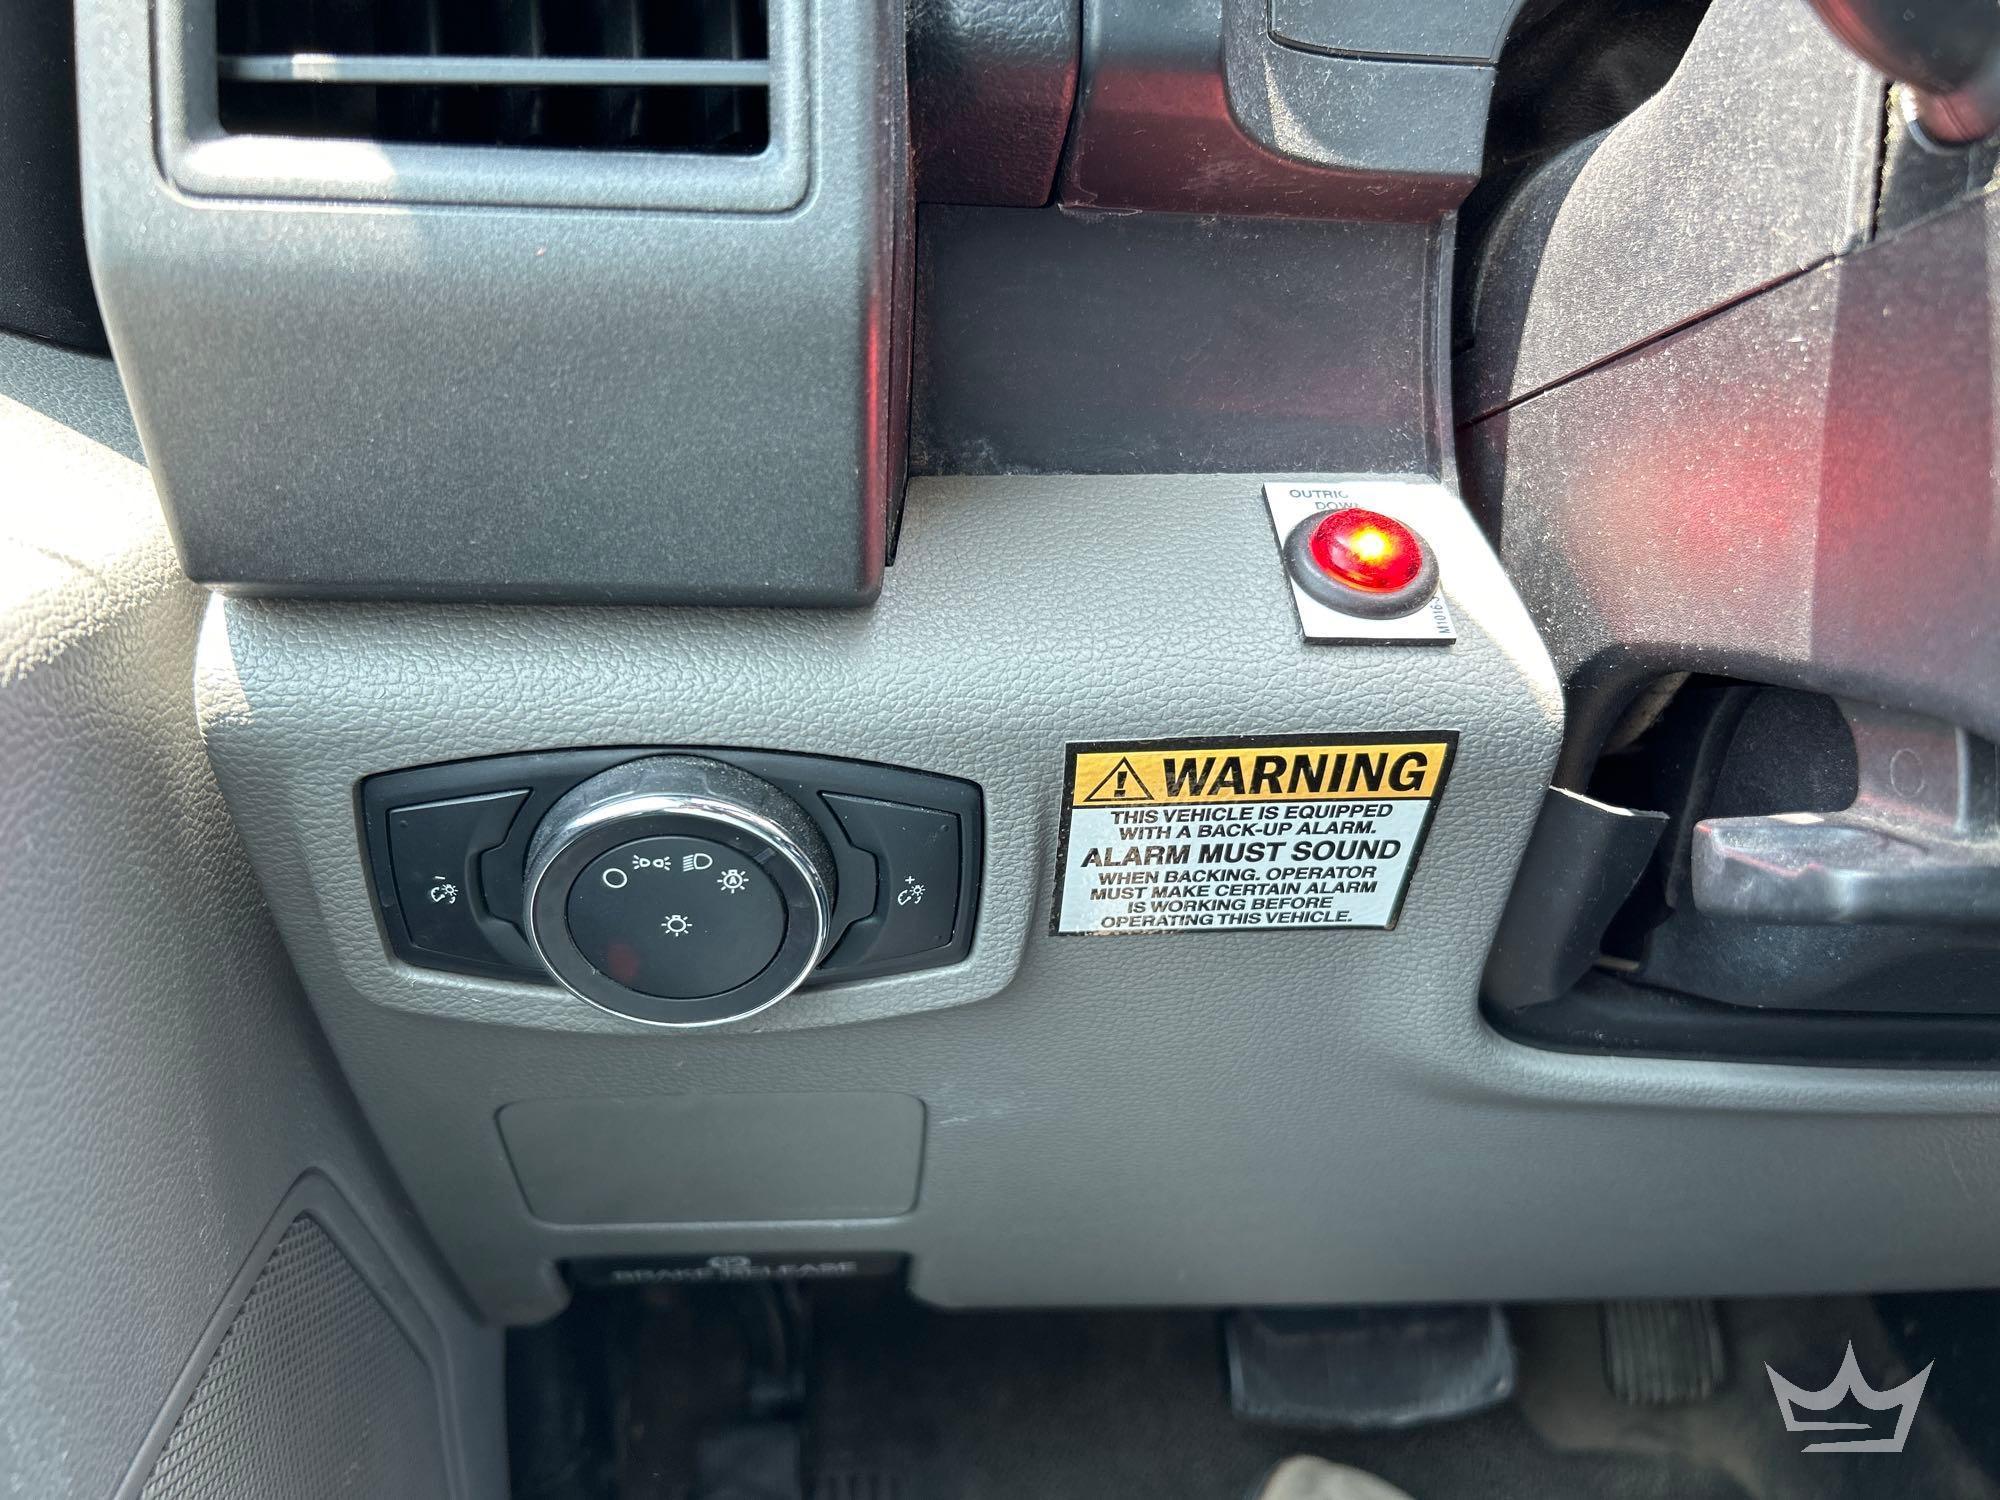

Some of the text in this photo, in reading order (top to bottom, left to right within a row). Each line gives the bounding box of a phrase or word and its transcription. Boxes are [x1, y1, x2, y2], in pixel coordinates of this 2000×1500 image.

[1162, 751, 1428, 797] WARNING
[1110, 803, 1393, 825] THIS VEHICLE IS EQUIPPED
[1119, 820, 1377, 840] WITH A BACK-UP ALARM.
[1080, 839, 1402, 868] ALARM MUST SOUND
[1098, 866, 1377, 885] WHEN BACKING. OPERATOR
[1090, 881, 1378, 900] MUST MAKE CERTAIN ALARM
[1127, 896, 1334, 913] IS WORKING BEFORE
[1101, 910, 1353, 928] OPERATING THIS VEHICLE.
